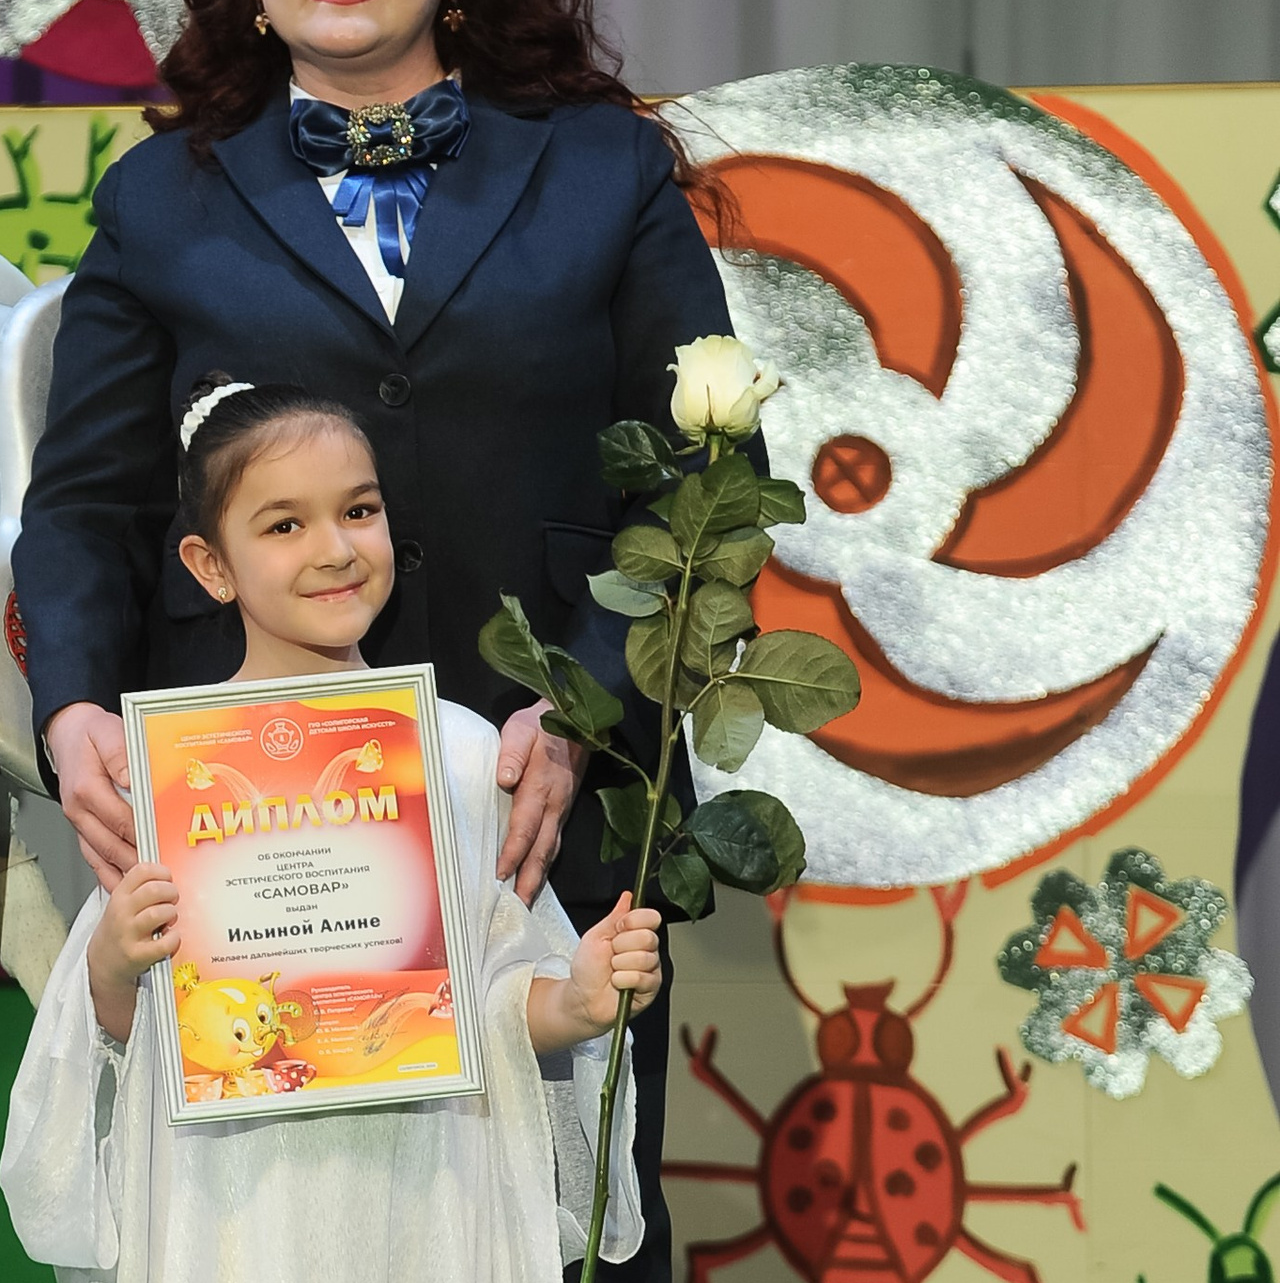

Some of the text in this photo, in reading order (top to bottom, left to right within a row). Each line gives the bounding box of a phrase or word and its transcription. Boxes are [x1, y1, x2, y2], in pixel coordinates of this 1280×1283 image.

[186, 784, 400, 848] ДИПЛОМ
[257, 847, 332, 861] ОБ ОКОНЧАНИИ
[225, 865, 370, 887] ЭСТЕТИЧЕСКОГО ВОСПИТАНИЯ
[276, 861, 314, 872] ЦЕНТРА
[254, 881, 349, 900] «САМОВАР»
[285, 904, 318, 913] выдан
[228, 916, 381, 943] Ильиной Алине
[211, 937, 404, 964] Желаем дальнейших творческих успехов!
